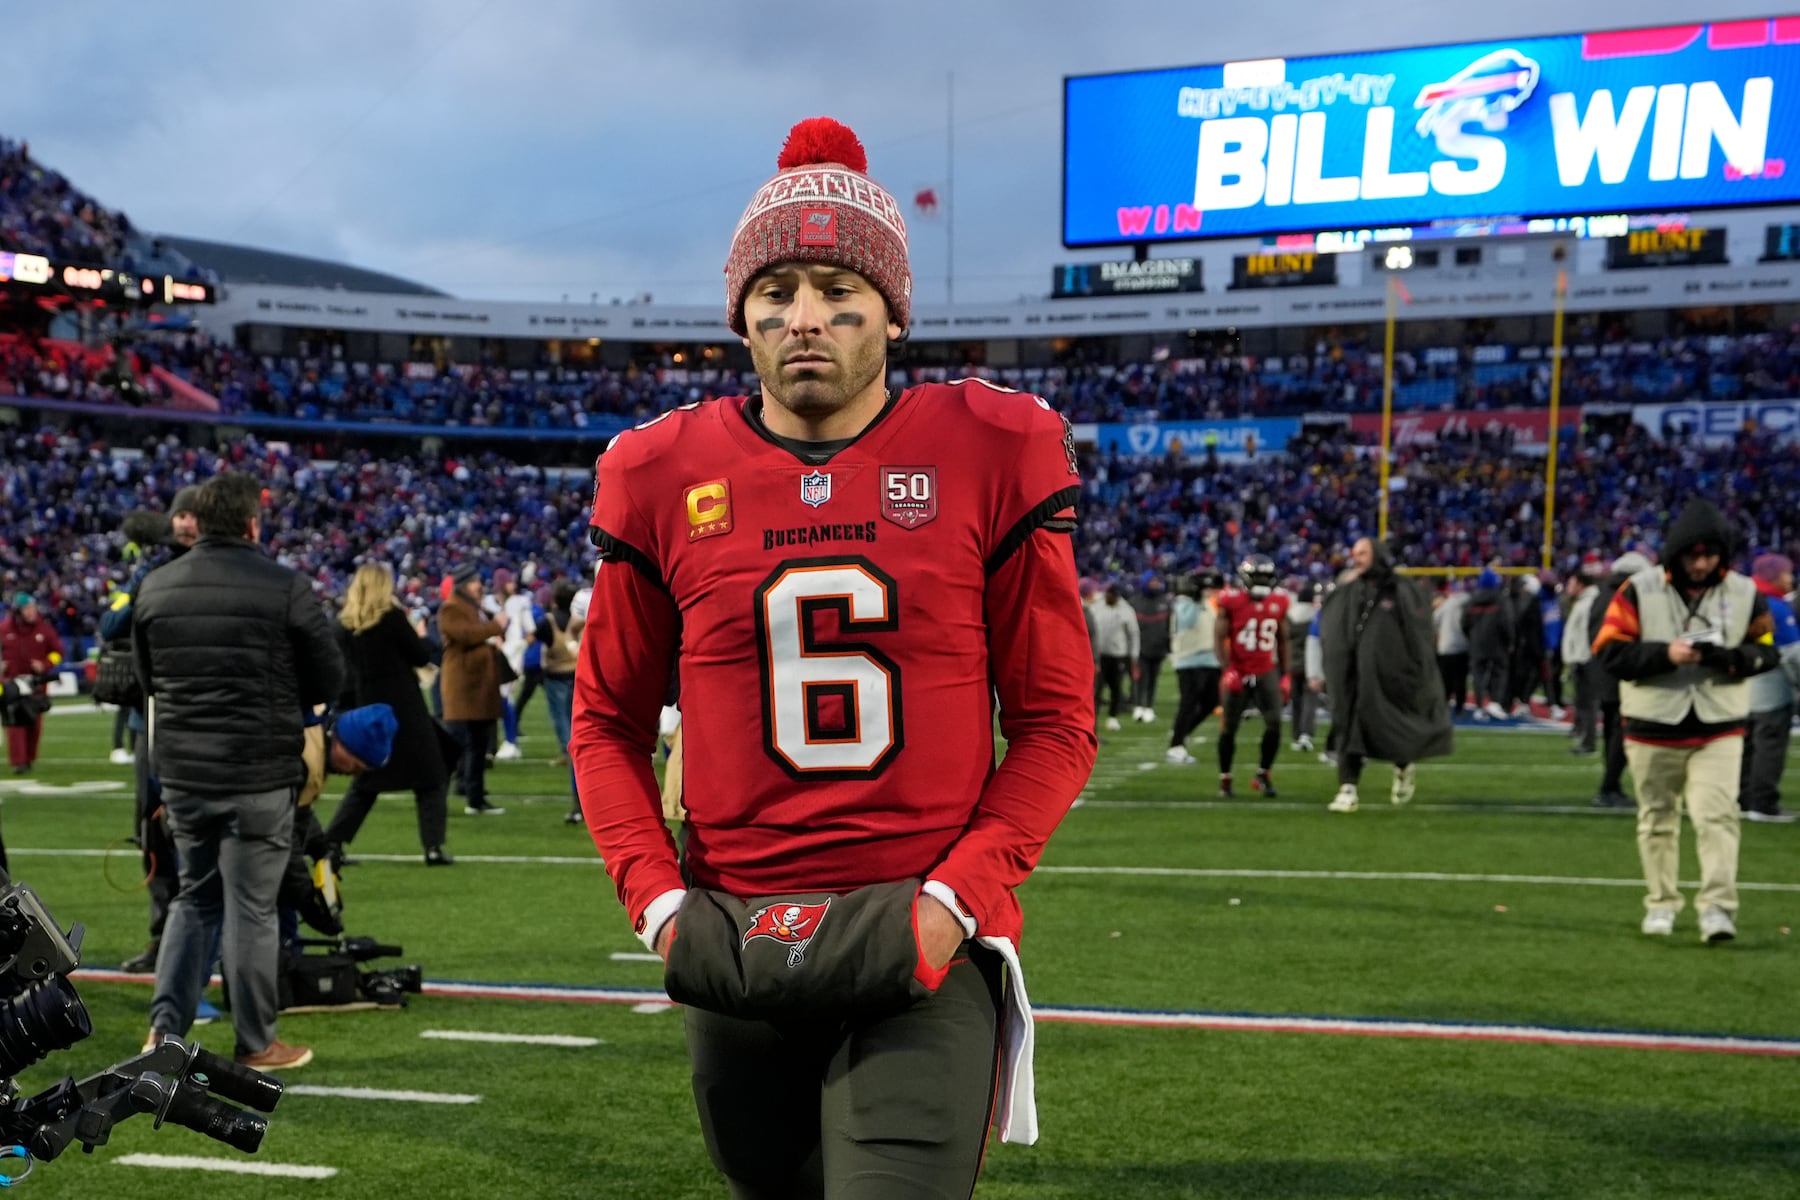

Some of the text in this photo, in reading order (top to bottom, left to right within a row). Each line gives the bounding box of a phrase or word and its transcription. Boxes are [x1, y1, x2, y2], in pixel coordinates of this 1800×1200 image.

[1194, 76, 1773, 211] BILLS WIN
[1117, 203, 1203, 236] WIN
[1629, 230, 1706, 256] HUNT
[1101, 257, 1194, 281] IMAGINE
[1248, 252, 1316, 276] HUNT
[1661, 405, 1800, 436] GEIC
[806, 486, 826, 500] NFL
[888, 472, 930, 501] 50
[687, 484, 728, 527] C
[763, 521, 877, 551] BUCCANEERS
[1236, 617, 1278, 652] 49
[756, 557, 902, 778] 6
